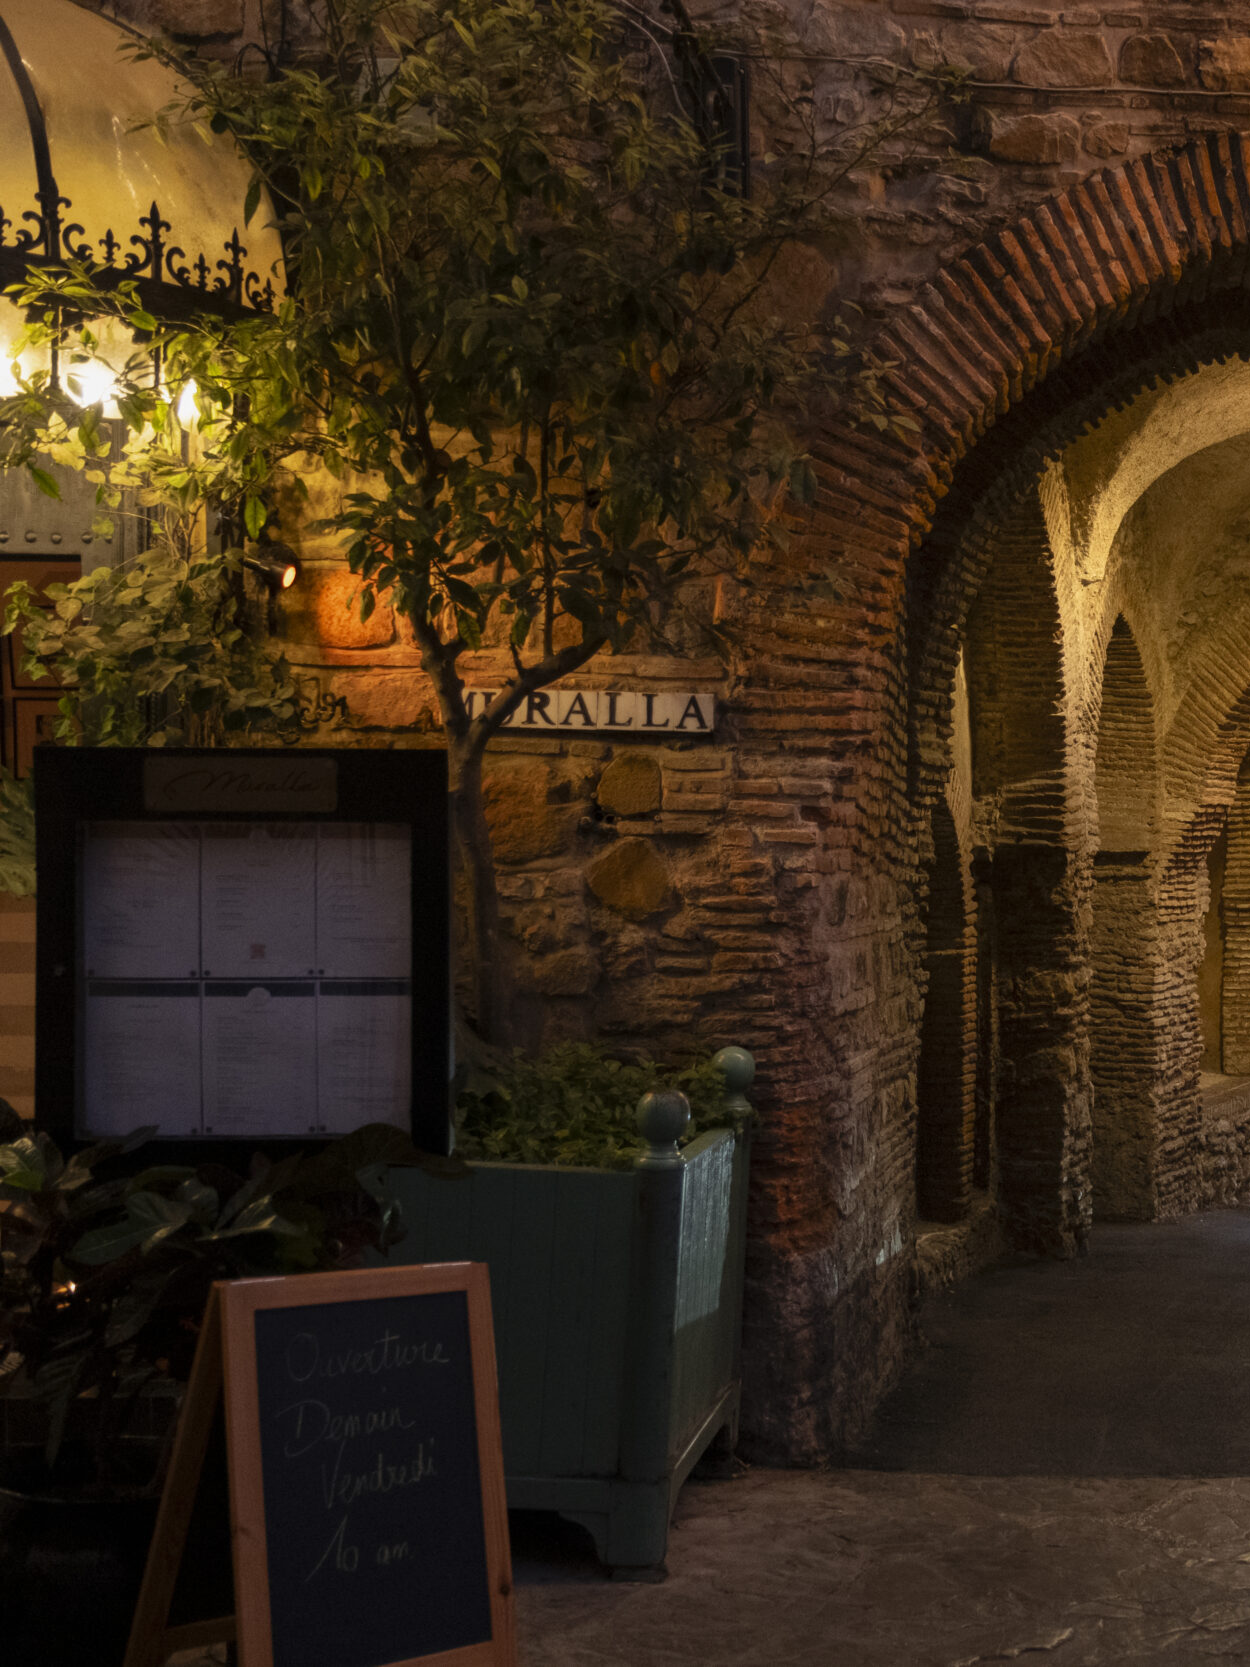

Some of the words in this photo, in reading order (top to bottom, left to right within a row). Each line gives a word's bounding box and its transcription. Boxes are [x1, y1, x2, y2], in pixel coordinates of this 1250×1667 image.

[286, 1329, 450, 1382] Ouverture
[274, 1399, 416, 1458] Demain
[321, 1437, 437, 1510] Vendredi
[304, 1513, 359, 1583] 10
